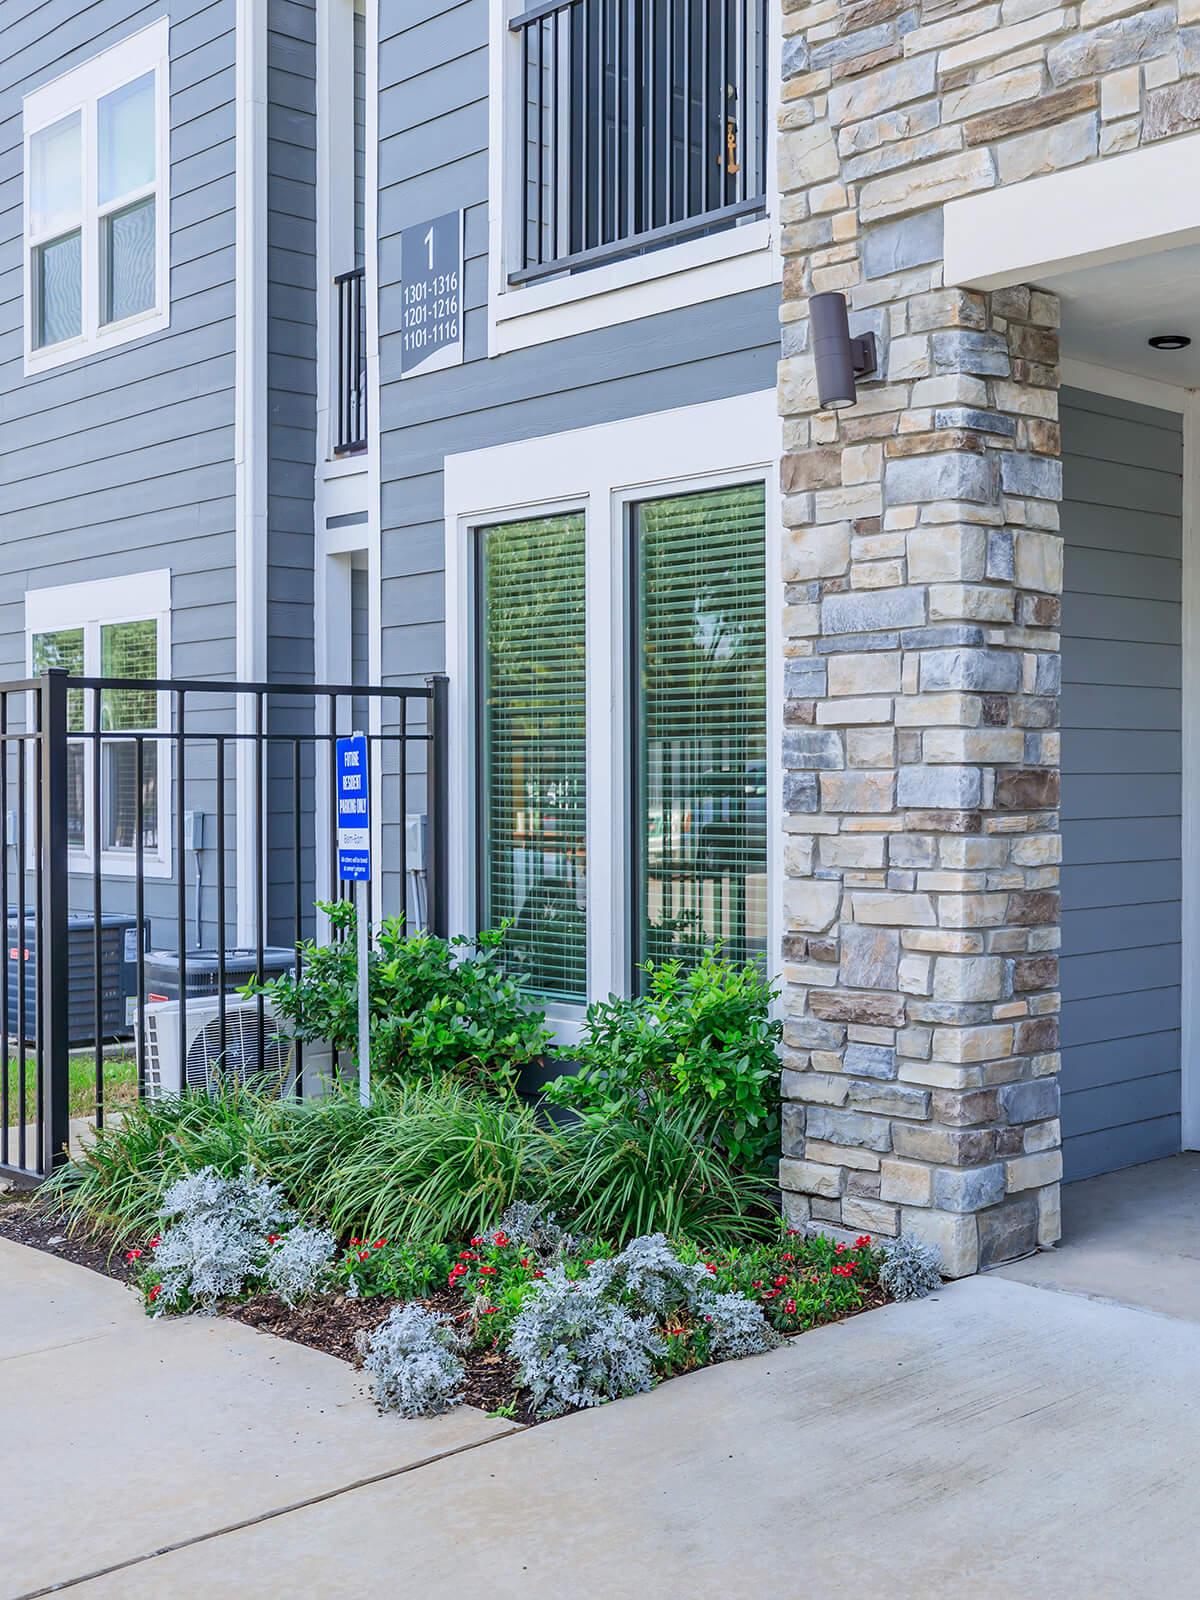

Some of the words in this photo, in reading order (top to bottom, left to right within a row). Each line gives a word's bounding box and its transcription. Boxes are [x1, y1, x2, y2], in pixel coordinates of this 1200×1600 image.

[424, 226, 434, 270] 1
[404, 271, 458, 305] 1301-1316
[404, 295, 458, 328] 1201-1216
[404, 318, 458, 351] 1101-1116
